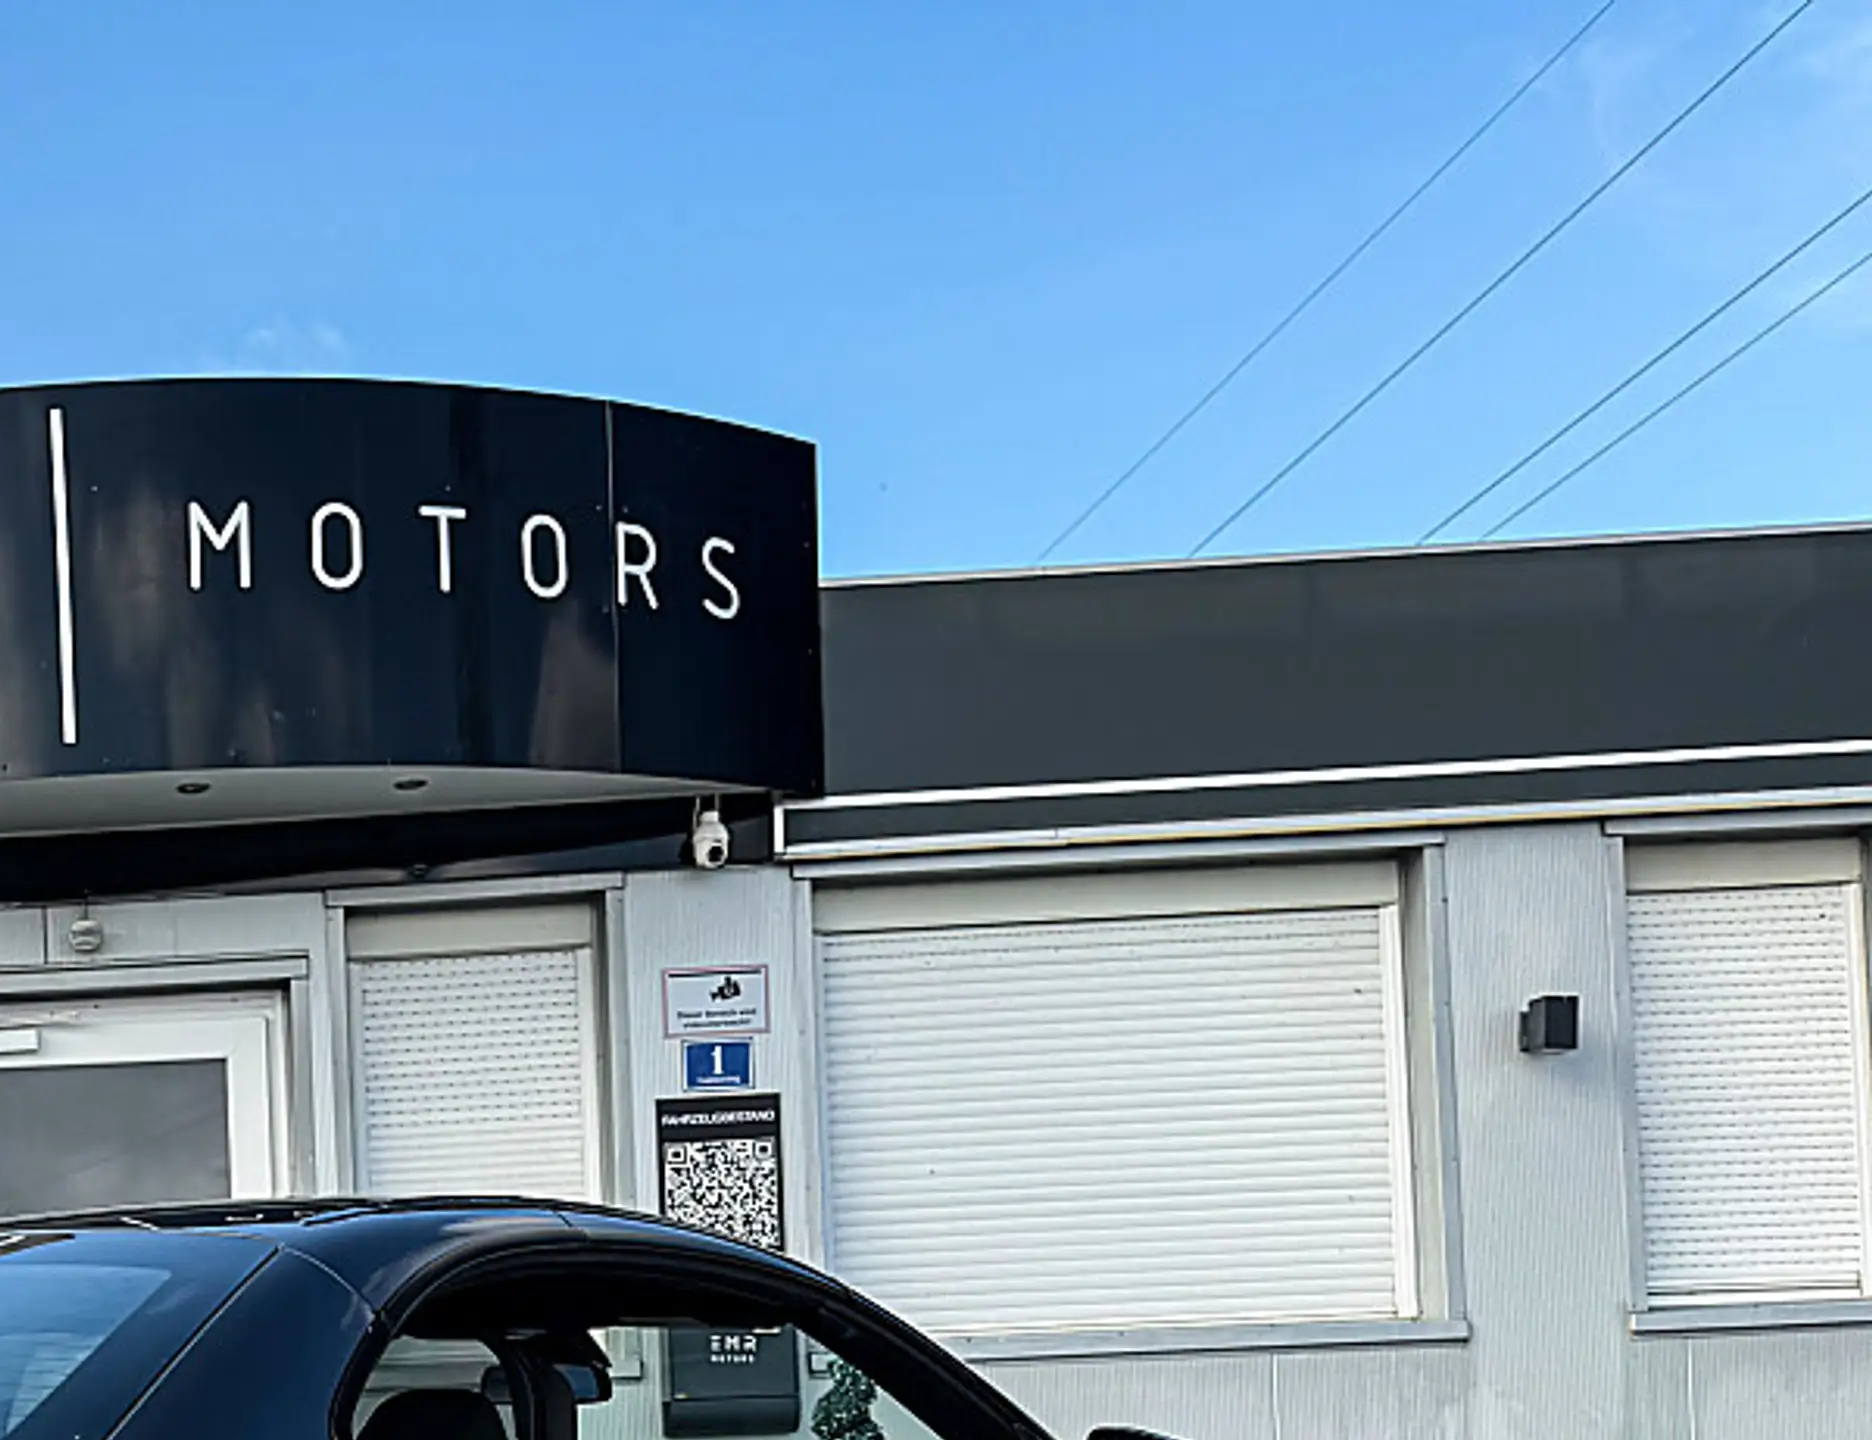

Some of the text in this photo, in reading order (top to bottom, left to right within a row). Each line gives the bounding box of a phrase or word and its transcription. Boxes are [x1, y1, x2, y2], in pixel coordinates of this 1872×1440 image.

[188, 501, 741, 620] MOTORS
[709, 1044, 725, 1075] 1
[710, 1335, 757, 1352] EMR
